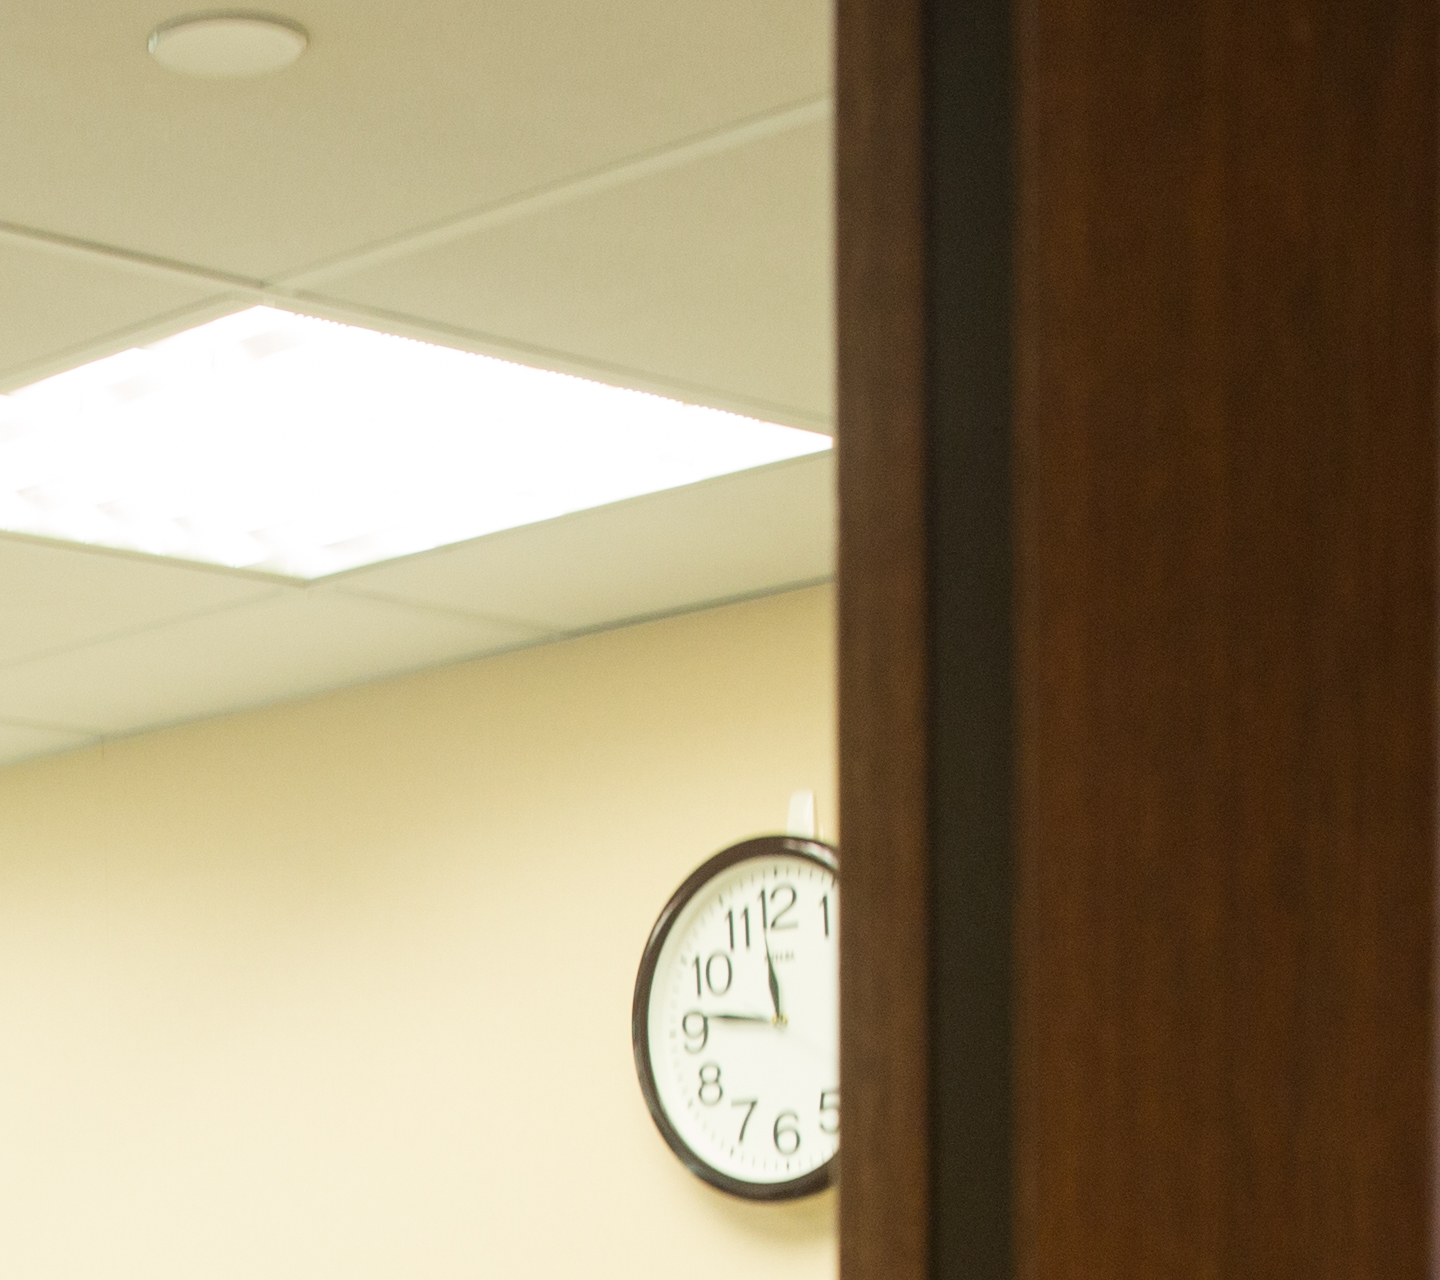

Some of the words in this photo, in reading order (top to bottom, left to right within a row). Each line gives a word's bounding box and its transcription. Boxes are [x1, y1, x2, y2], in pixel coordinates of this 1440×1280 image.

[725, 906, 750, 950] 11
[758, 882, 799, 931] 12
[820, 893, 830, 939] 1
[692, 952, 733, 997] 10
[682, 1011, 708, 1055] 9
[698, 1063, 723, 1107] 8
[731, 1098, 758, 1144] 7
[773, 1109, 801, 1156] 6
[819, 1088, 839, 1134] 5
